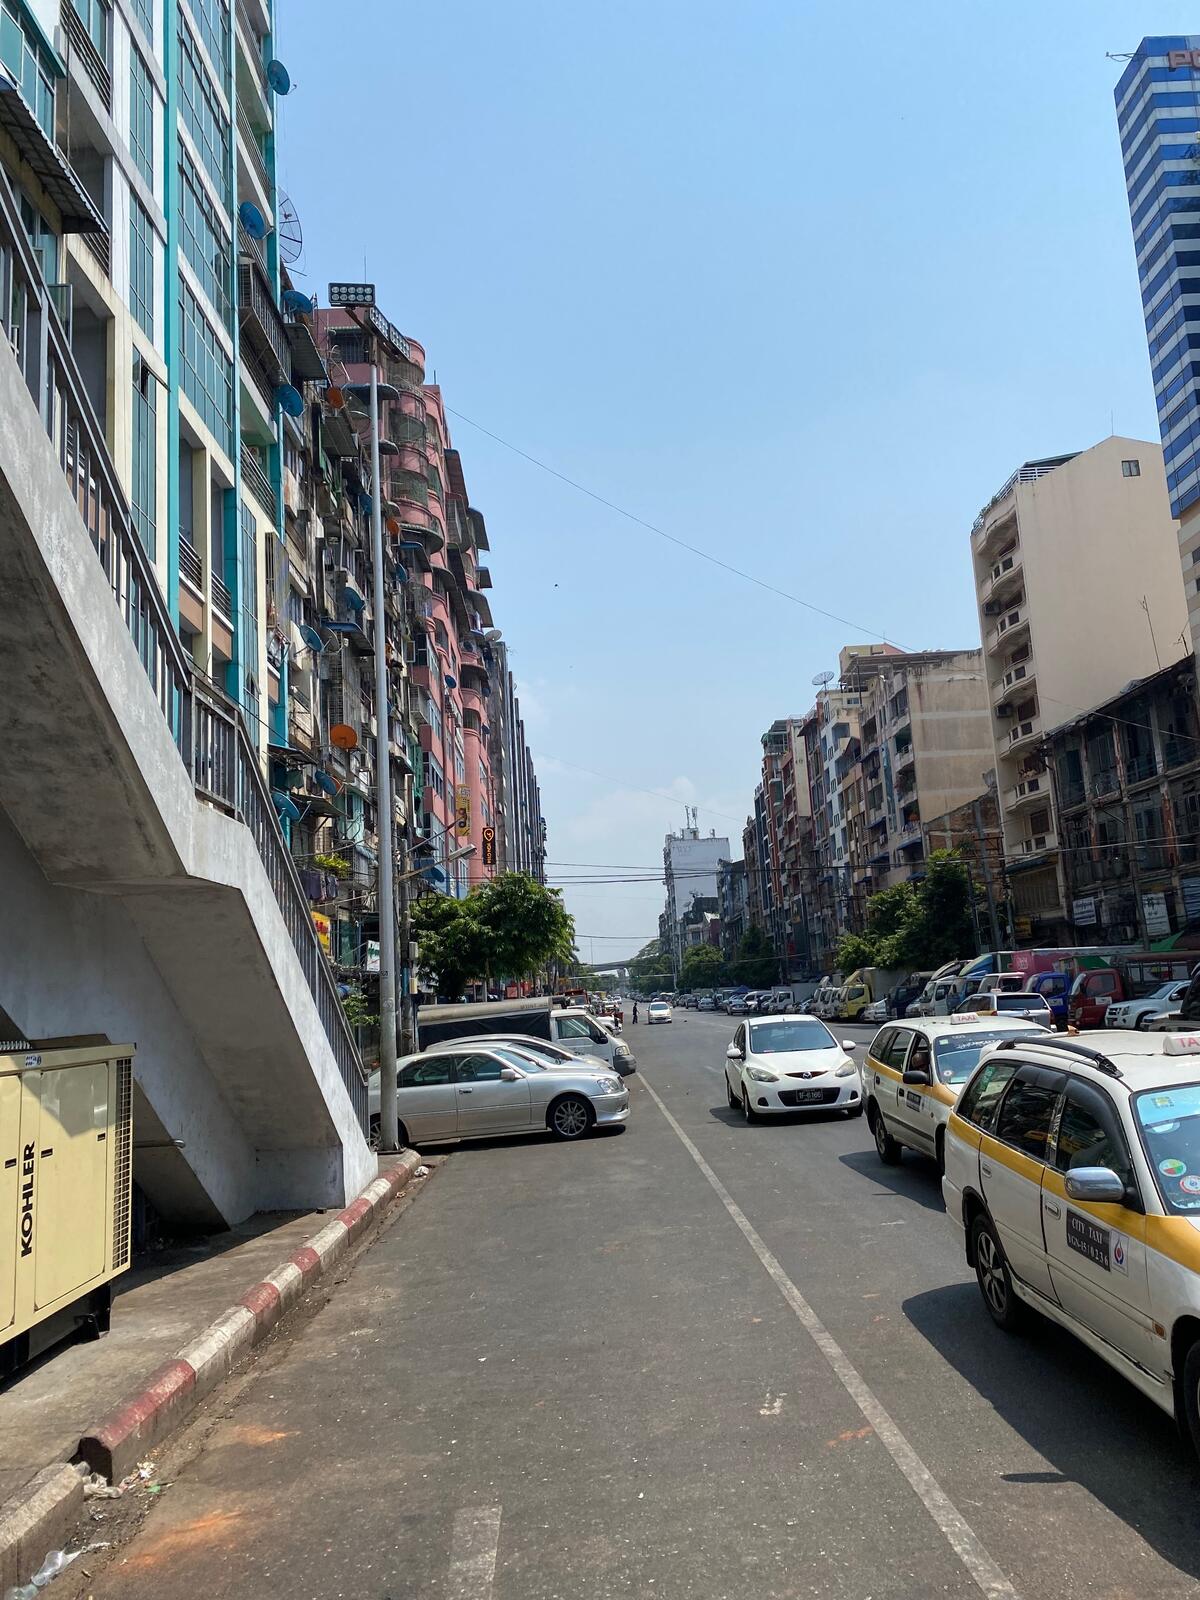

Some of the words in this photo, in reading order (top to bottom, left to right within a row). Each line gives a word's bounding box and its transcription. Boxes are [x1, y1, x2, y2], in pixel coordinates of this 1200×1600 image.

[957, 1014, 976, 1022] TAXI
[21, 1141, 35, 1258] KOHLER
[1071, 1217, 1086, 1234] CITY
[1089, 1226, 1103, 1245] TAXI
